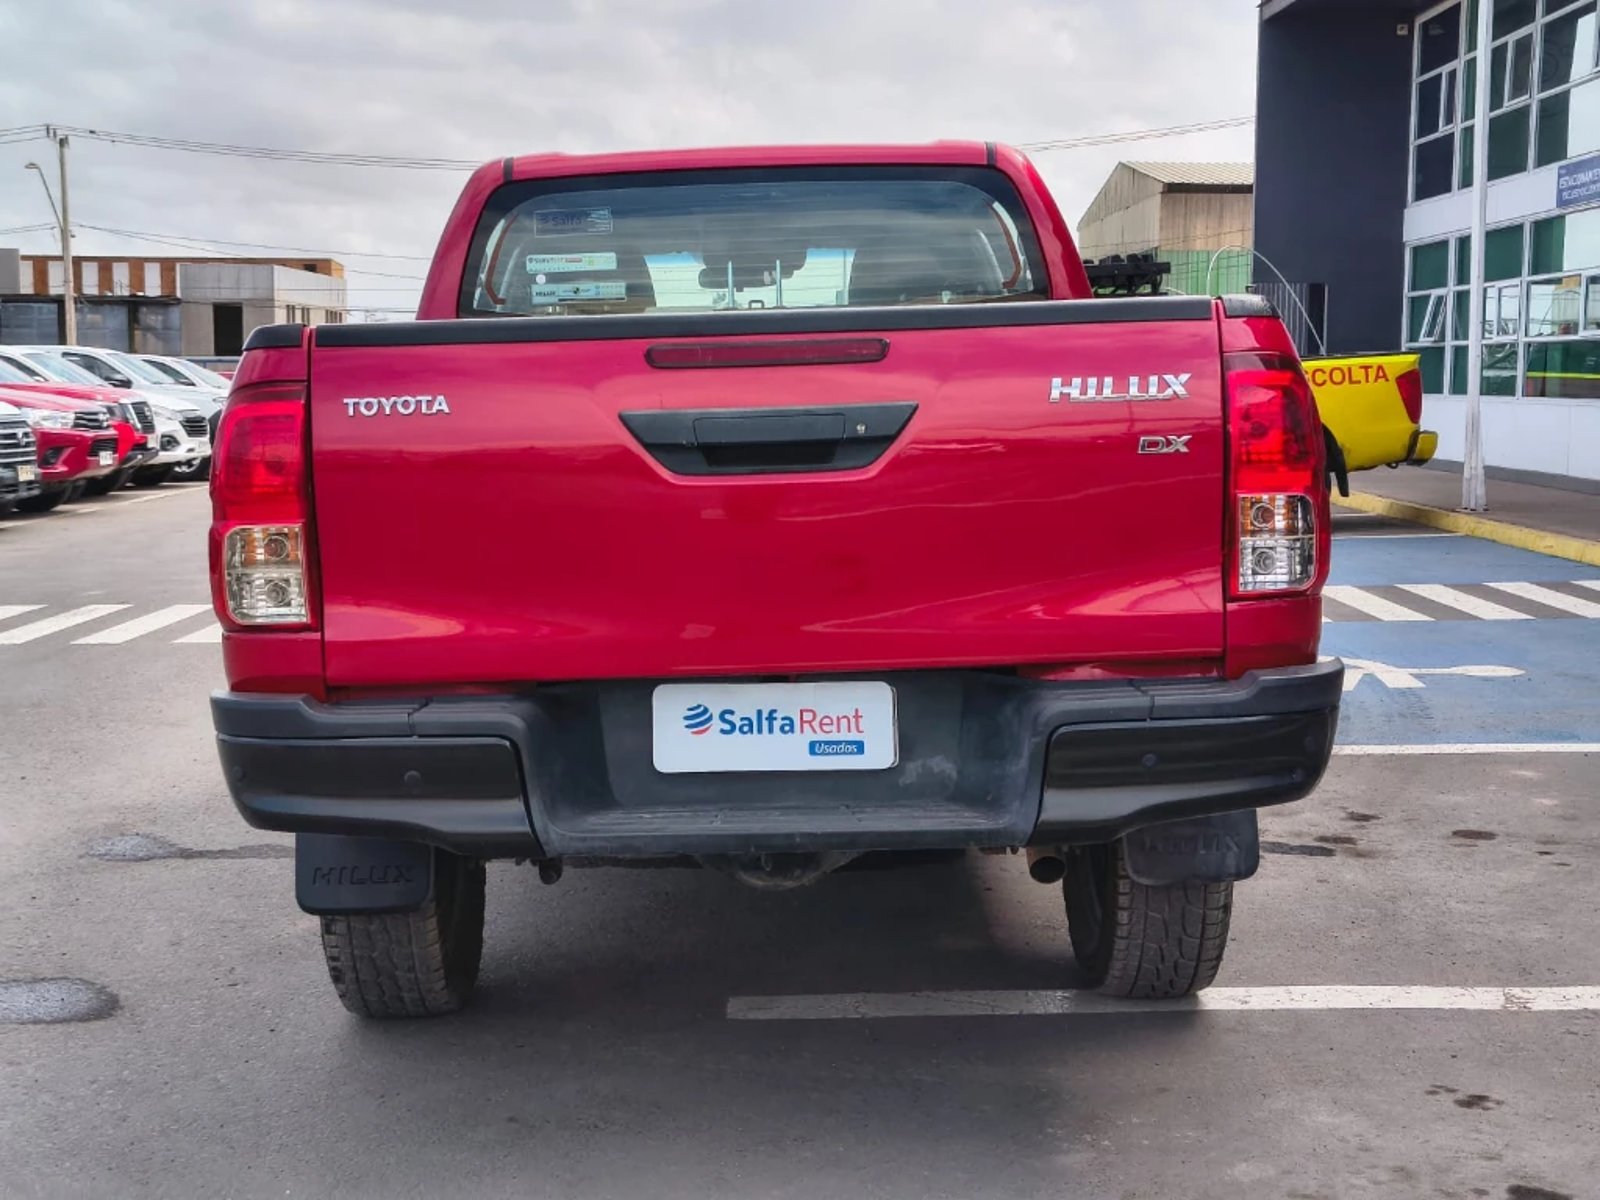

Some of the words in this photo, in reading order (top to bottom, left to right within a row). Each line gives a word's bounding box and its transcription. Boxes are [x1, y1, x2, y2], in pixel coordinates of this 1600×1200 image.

[1049, 373, 1192, 402] HILUX
[343, 395, 451, 417] TOYOTA
[1137, 435, 1192, 454] DX
[718, 708, 864, 735] SalfaRent
[815, 742, 858, 754] Usados
[312, 864, 413, 886] HILUX
